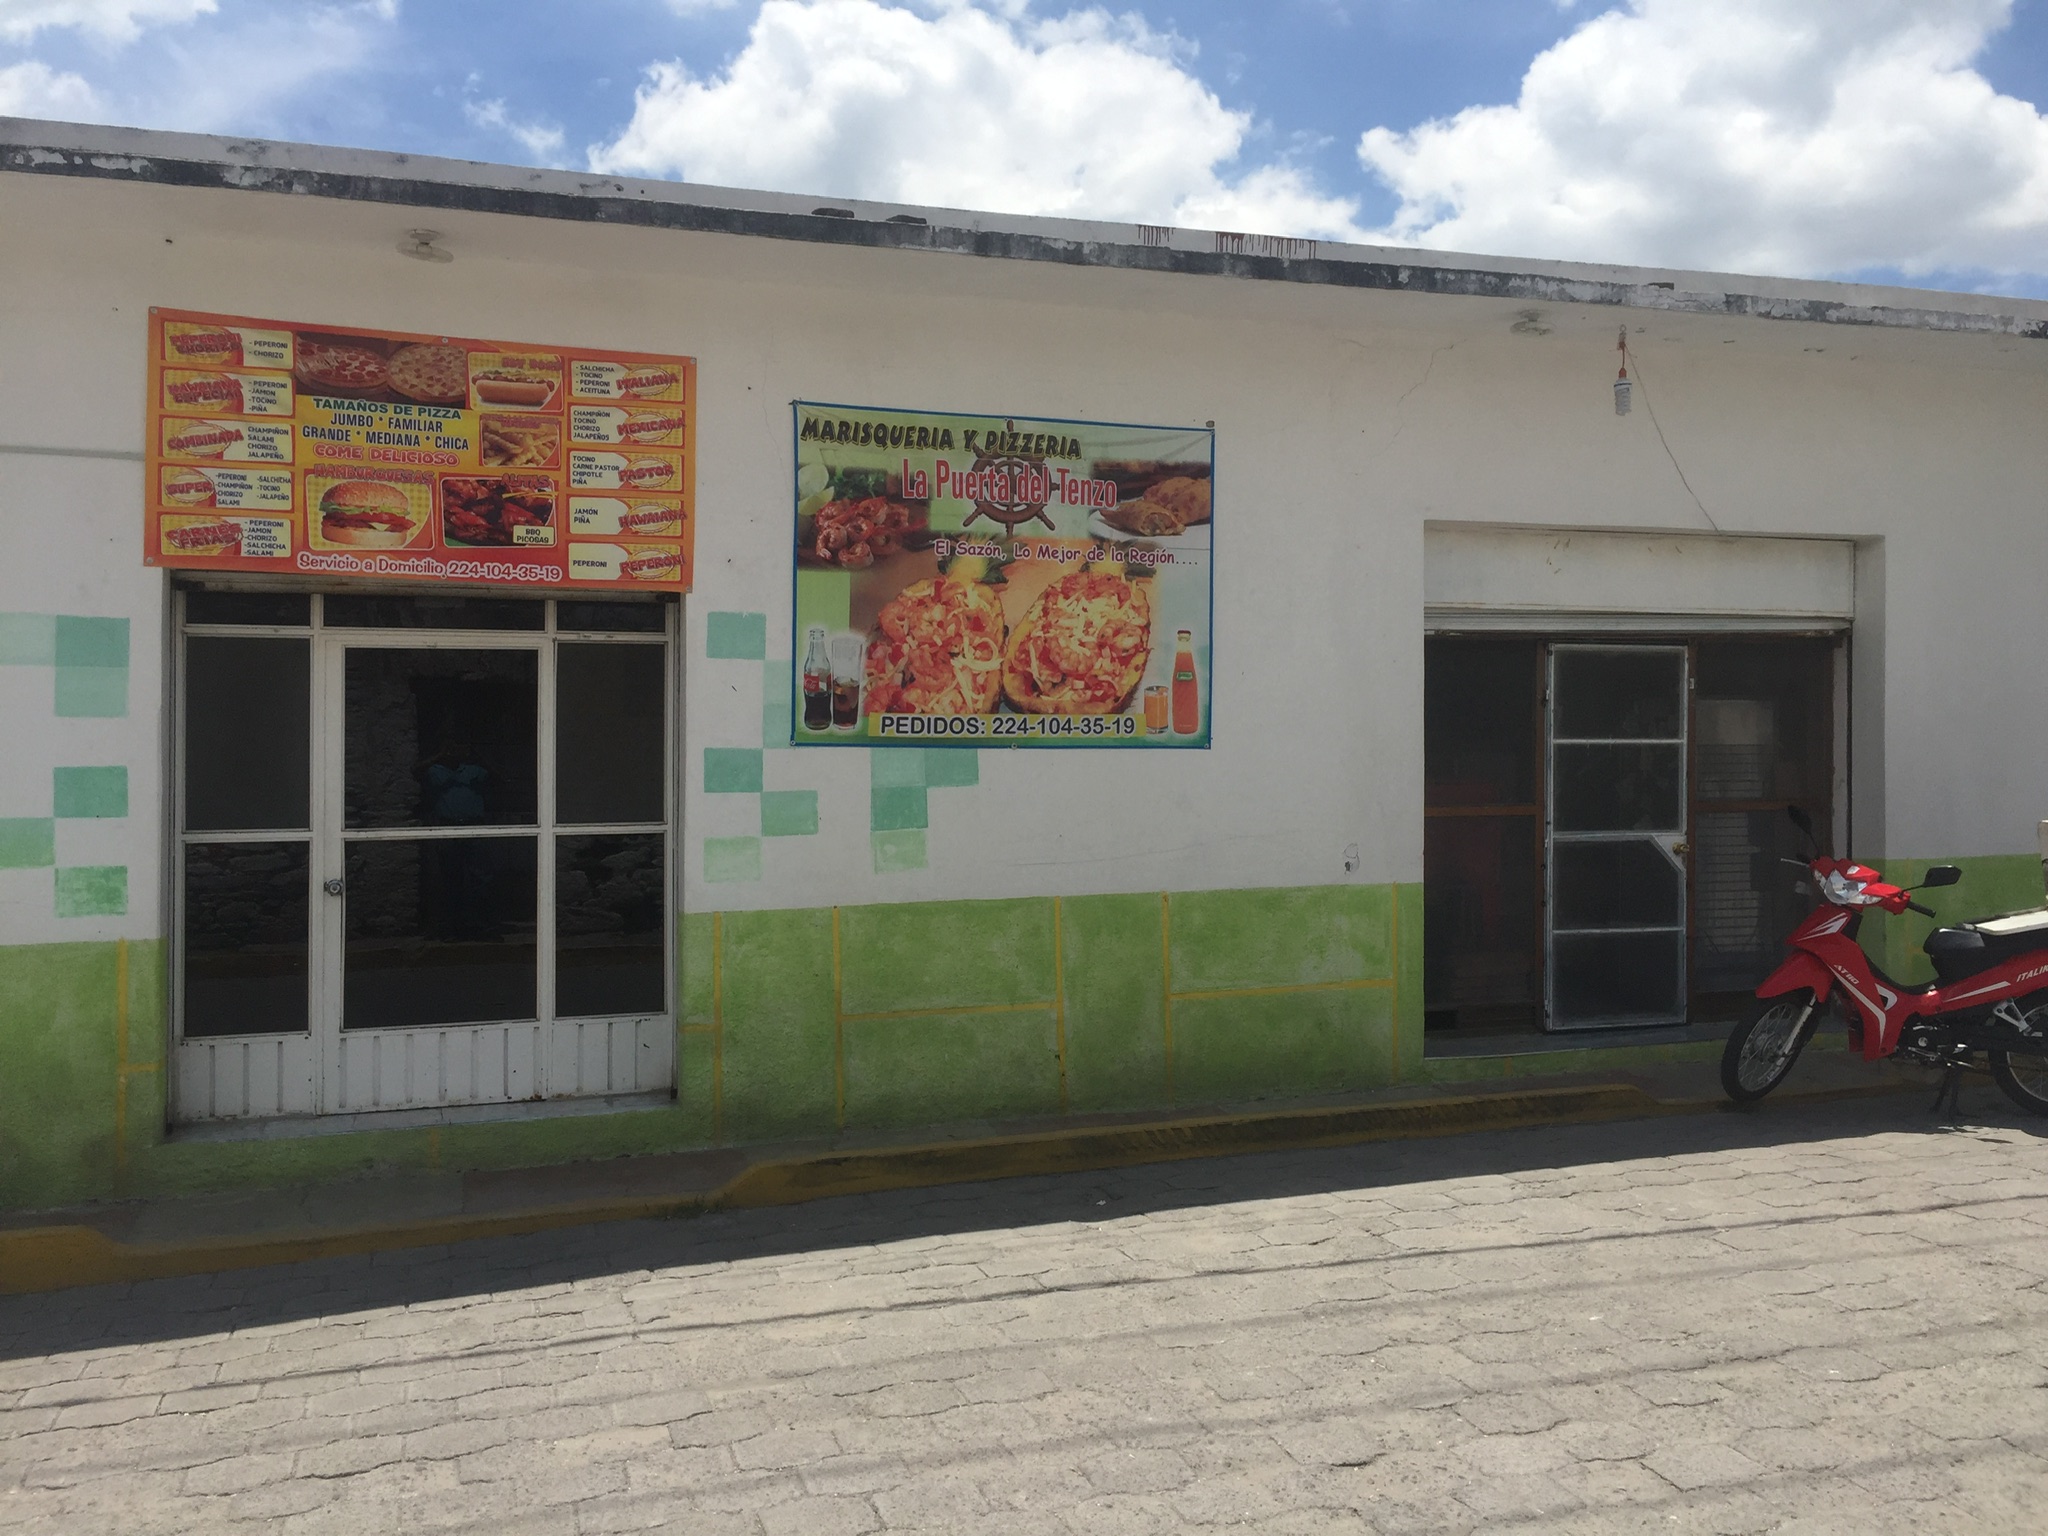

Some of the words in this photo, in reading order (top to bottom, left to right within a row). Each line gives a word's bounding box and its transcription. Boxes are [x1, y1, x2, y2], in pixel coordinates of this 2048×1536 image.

[254, 340, 288, 349] PEPERONI
[254, 350, 284, 359] CHORIZO
[580, 364, 615, 372] SALCHICHA
[254, 380, 288, 389] PEPERONI
[616, 373, 679, 390] ITALIANA
[313, 398, 389, 414] TAMAÑOS
[393, 405, 414, 416] DE
[417, 407, 462, 420] PIZZA
[573, 410, 611, 418] CHAMPIÑON
[330, 412, 374, 428] JUMBO
[388, 417, 443, 433] FAMILIAR
[617, 417, 686, 436] MEXICANA
[248, 426, 289, 436] CHAMPIÑON
[167, 429, 244, 450] COMBINADA
[248, 434, 274, 443] SALAMI
[302, 426, 351, 442] GRANDE
[365, 430, 421, 447] MEDIANA
[435, 436, 469, 451] CHICA
[573, 432, 609, 441] JALAPEÑOS
[801, 417, 955, 451] MARISQUERIA
[963, 429, 978, 451] Y
[985, 430, 1082, 460] PIZZERIA
[248, 442, 278, 452] CHORIZO
[248, 451, 284, 460] JALAPEÑO
[313, 443, 364, 460] COME
[369, 448, 460, 467] DELICIOSO
[572, 455, 596, 463] TOCINO
[594, 464, 620, 472] PASTOR
[618, 464, 675, 482] PASTOR
[314, 464, 435, 484] HAMBURGUESAS
[572, 470, 603, 478] CHIPOTLE
[501, 472, 551, 489] ALITAS
[572, 478, 588, 486] PIÑA
[902, 458, 928, 500] La
[936, 460, 1010, 502] Puerta
[1017, 462, 1049, 504] del
[1056, 467, 1117, 507] Tenzo
[166, 481, 213, 496] SUPER
[574, 507, 598, 516] JAMÓN
[250, 520, 284, 528] PEPERONI
[574, 516, 591, 524] PIÑA
[165, 523, 243, 540] CARNES
[526, 528, 541, 536] BBQ
[935, 542, 950, 556] El
[956, 542, 1006, 561] Sazón,
[1014, 544, 1030, 559] Lo
[1037, 544, 1081, 564] Mejor
[1087, 544, 1105, 561] de
[1111, 546, 1124, 562] la
[299, 552, 359, 571] Servicio
[364, 560, 374, 571] a
[378, 558, 444, 575] Domicilio
[449, 562, 561, 580] 224-104-35-19
[572, 560, 608, 568] PEPERONI
[619, 553, 687, 574] PEPERONI
[880, 716, 986, 734] PEDIDOS:
[992, 716, 1136, 735] 224-104-35-19
